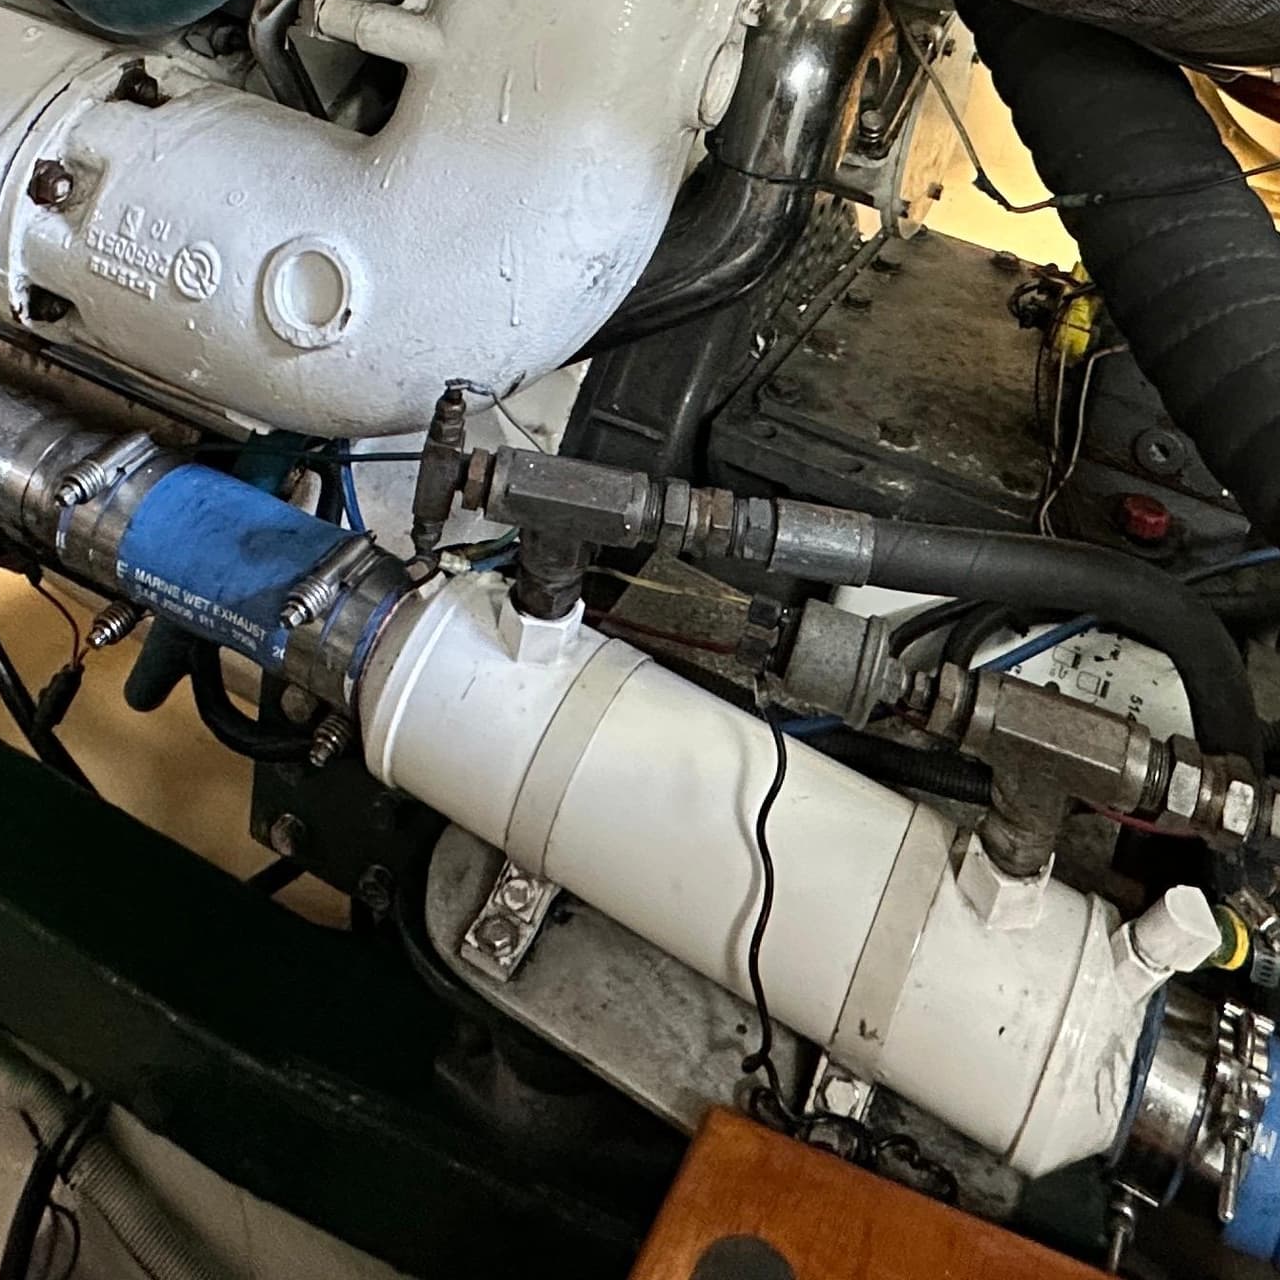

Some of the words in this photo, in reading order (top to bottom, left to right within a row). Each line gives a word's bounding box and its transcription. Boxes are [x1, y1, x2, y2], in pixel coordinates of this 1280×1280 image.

[134, 567, 180, 599] MARINE
[182, 589, 211, 613] WET
[213, 605, 267, 642] EXHAUST
